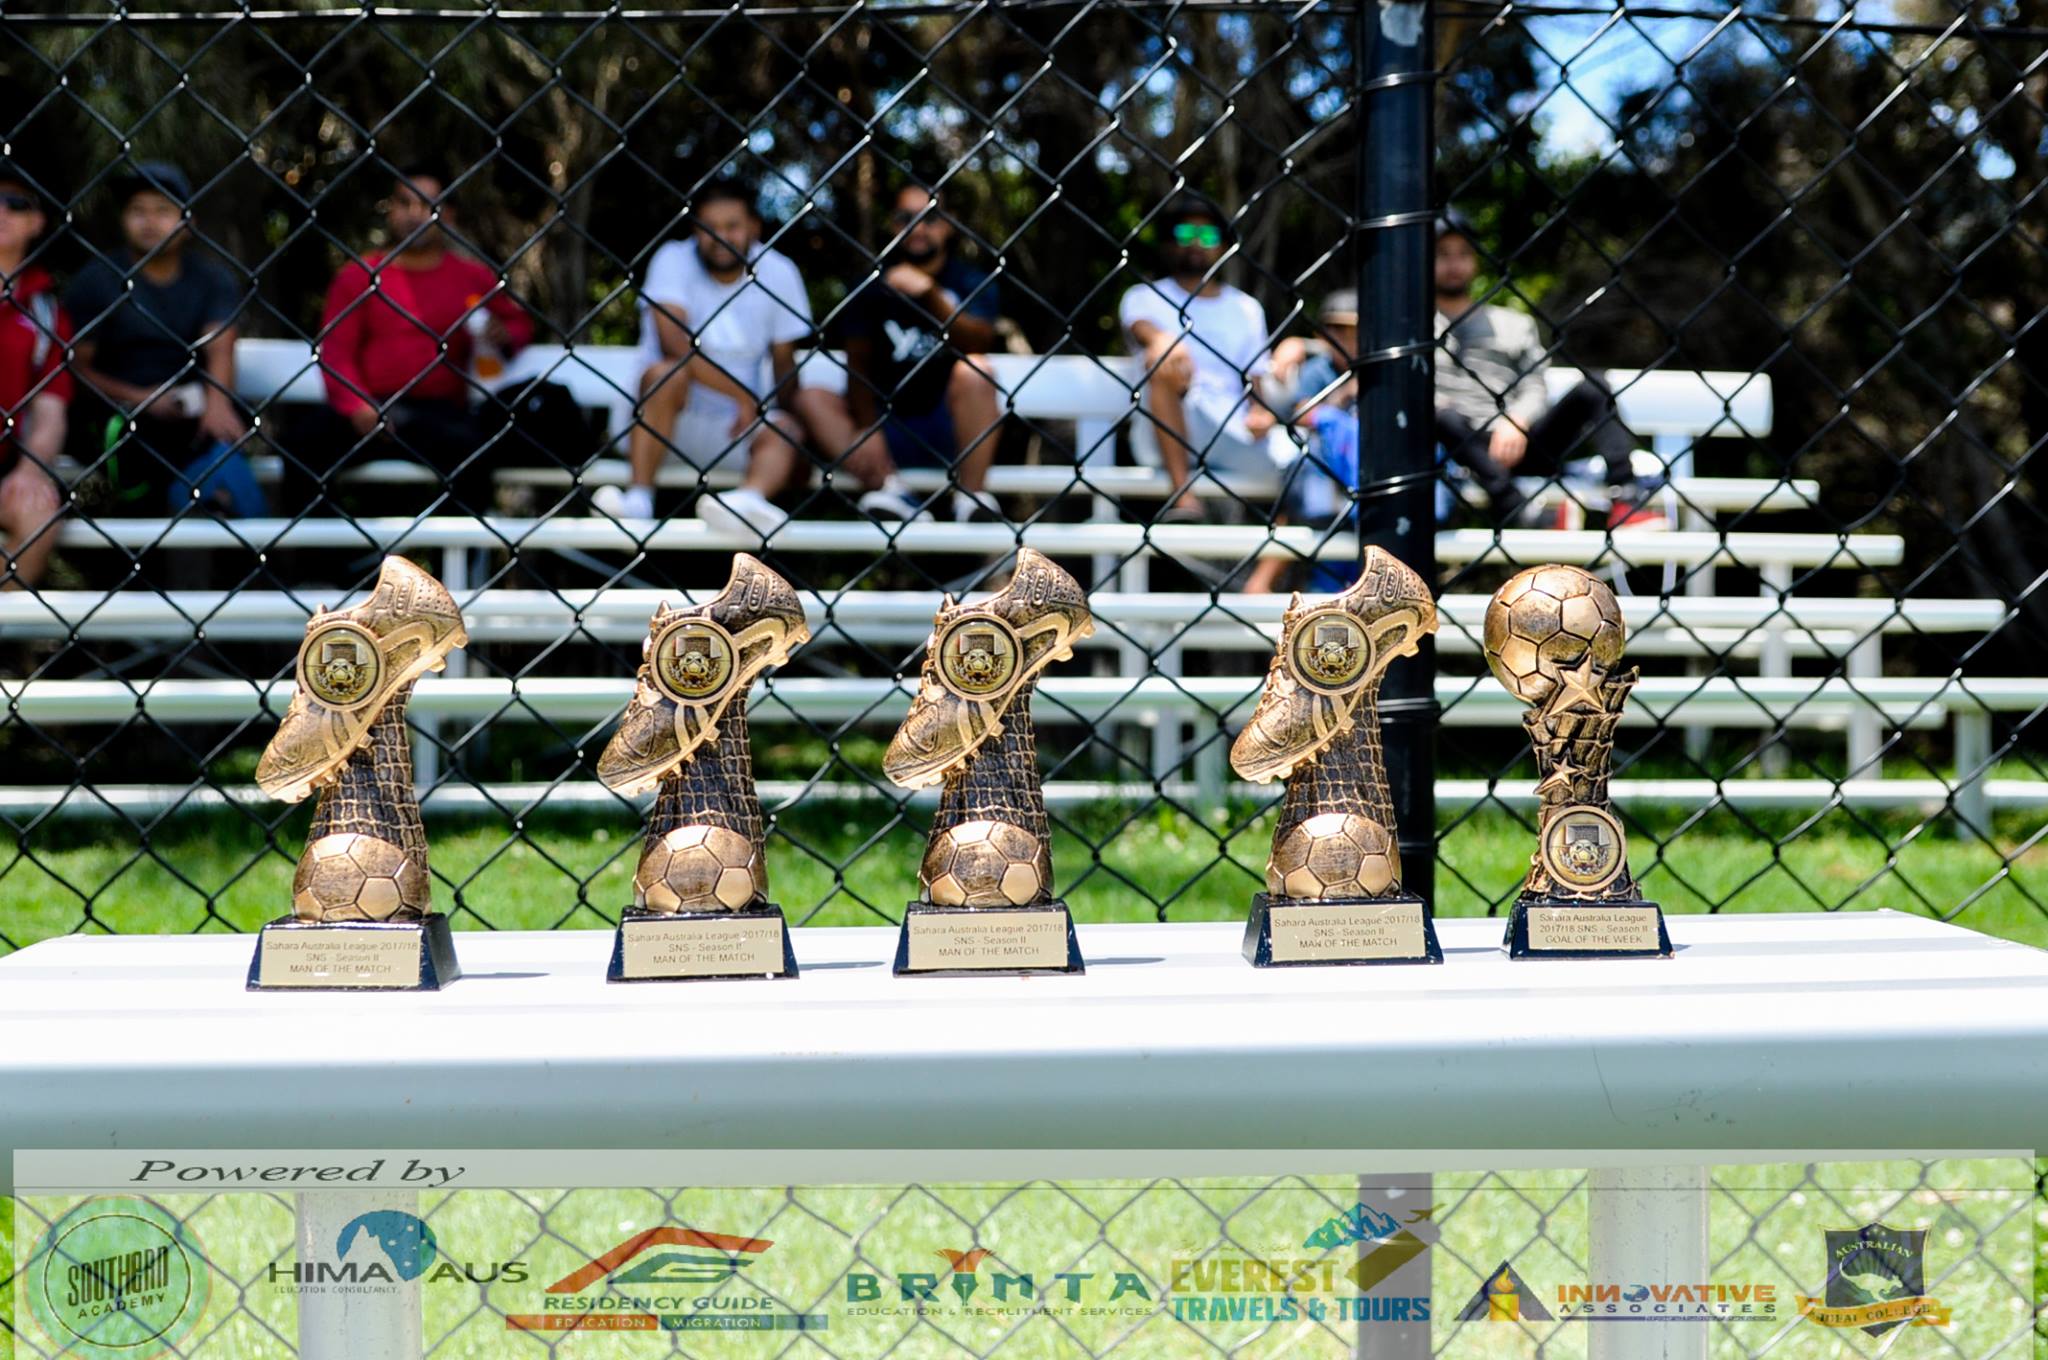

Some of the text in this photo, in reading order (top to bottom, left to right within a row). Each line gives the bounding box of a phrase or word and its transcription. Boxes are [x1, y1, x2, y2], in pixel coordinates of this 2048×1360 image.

[1275, 915, 1420, 927] Sahara Australia League 2017/18
[1540, 914, 1647, 924] Sahara Australia League
[913, 923, 1063, 934] Sahara Australia League 2017/18
[1314, 929, 1334, 937] SNS
[1343, 928, 1376, 936] Season
[1540, 925, 1574, 933] 2017/18
[1578, 925, 1598, 933] SNS
[1607, 925, 1640, 933] Season
[628, 929, 779, 942] Sahara Australia League 2017/18
[984, 936, 1017, 944] Season
[1546, 936, 1573, 944] GOAL
[1613, 935, 1642, 943] WEEK
[266, 941, 418, 951] Sahara Australia League 2017/18
[669, 944, 689, 952] SNS
[699, 943, 732, 952] Season
[1300, 940, 1322, 948] MAN
[1341, 939, 1359, 947] THE
[1363, 938, 1398, 947] MATCH
[939, 949, 961, 957] MAN
[1004, 947, 1039, 955] MATCH
[306, 953, 327, 962] SNS
[335, 953, 370, 962] Season
[653, 953, 755, 964] MAN OF THE MATCH
